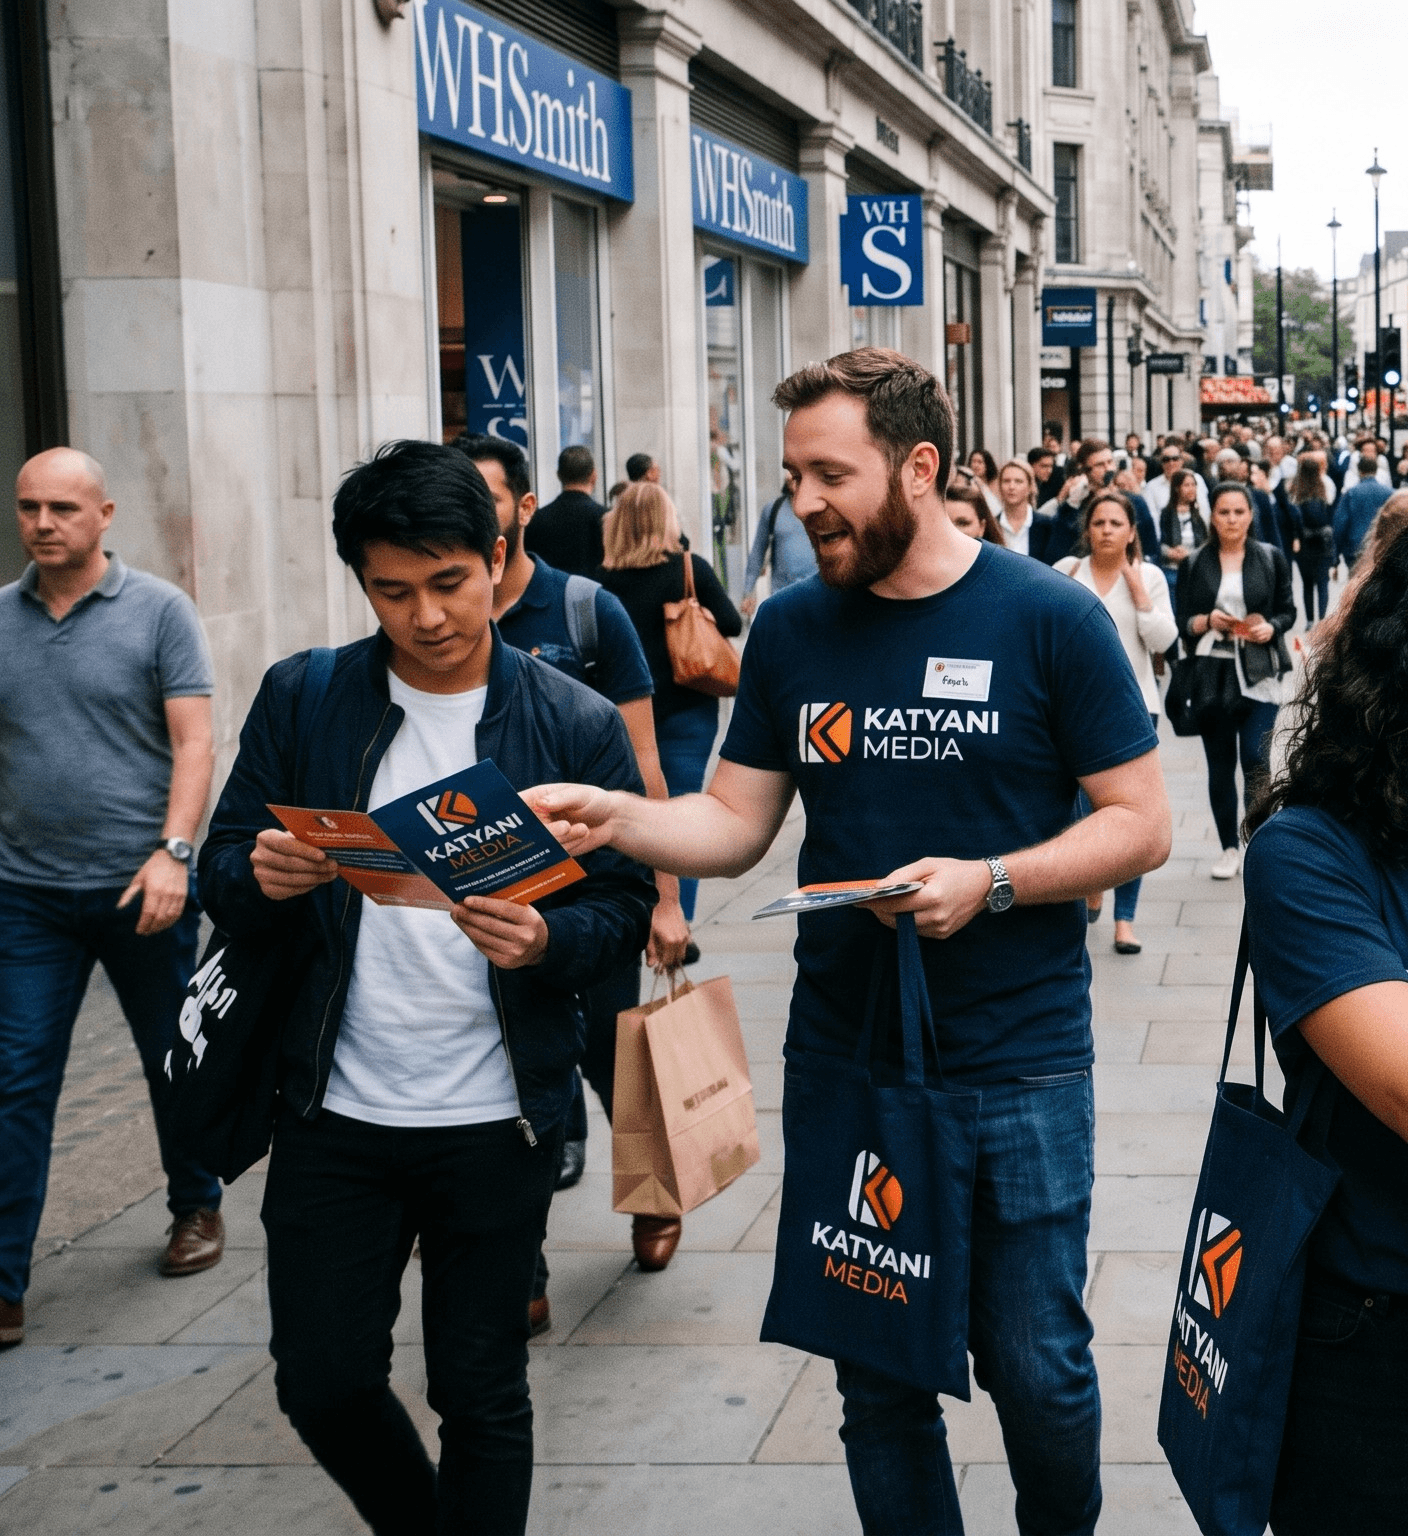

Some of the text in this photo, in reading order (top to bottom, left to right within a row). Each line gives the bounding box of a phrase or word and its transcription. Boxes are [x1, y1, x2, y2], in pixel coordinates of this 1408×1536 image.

[414, 0, 611, 183] WHSmith
[692, 134, 796, 252] WHSmith
[861, 201, 909, 223] WH
[862, 225, 912, 299] S
[863, 707, 999, 734] KATYANI
[863, 736, 963, 761] MEDIA
[424, 812, 523, 862] KATYANI
[449, 834, 522, 869] MEDIA
[812, 1221, 930, 1279] KATYANI
[824, 1255, 908, 1305] MEDIA
